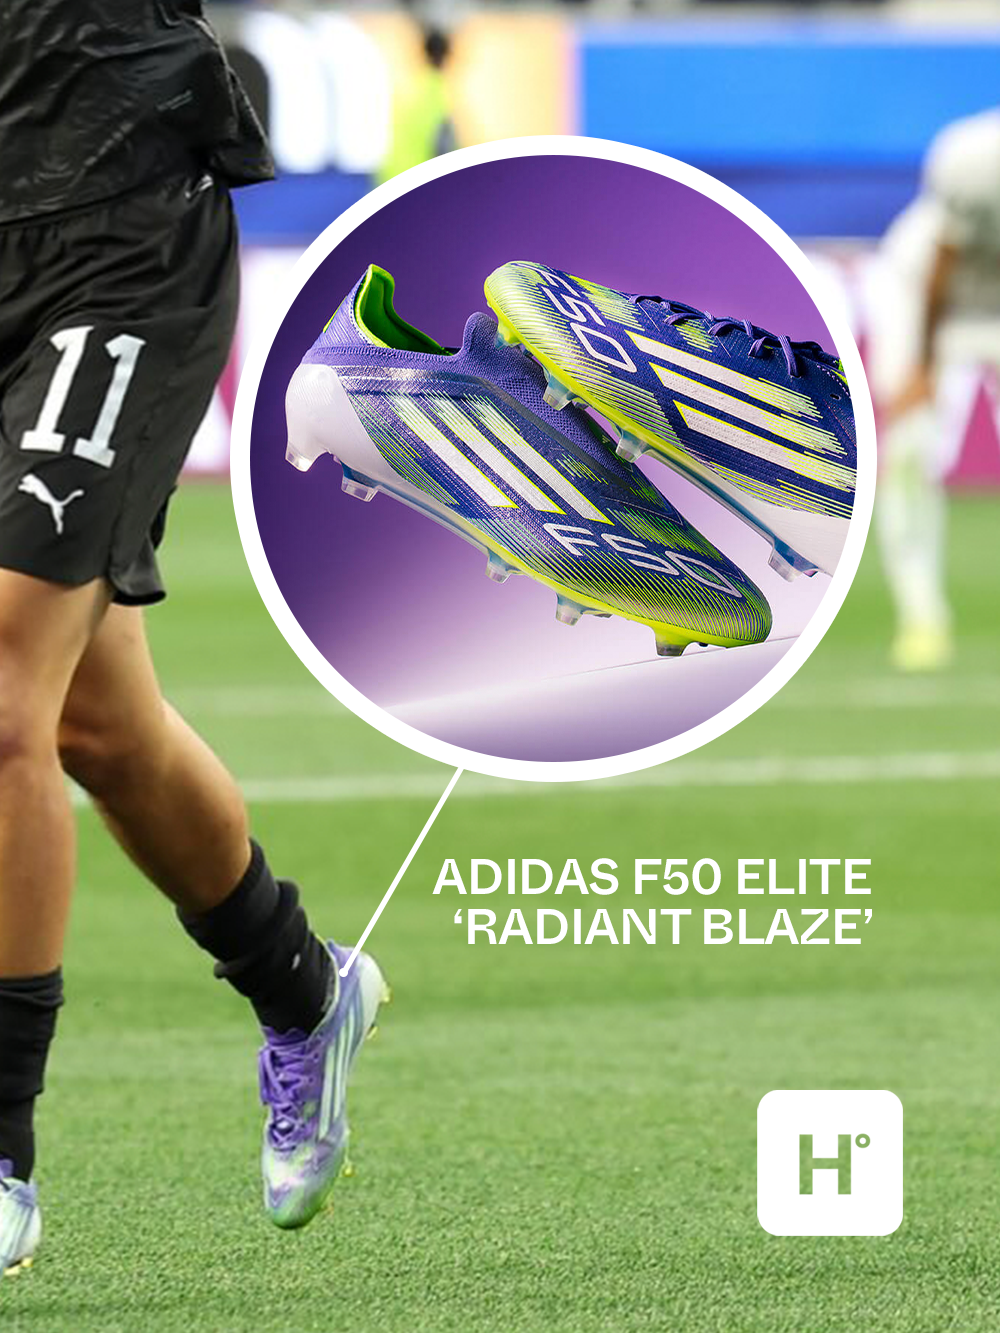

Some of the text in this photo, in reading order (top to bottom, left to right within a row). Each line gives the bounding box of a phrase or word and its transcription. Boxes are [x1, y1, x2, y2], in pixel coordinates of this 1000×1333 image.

[511, 262, 638, 373] F50
[20, 325, 146, 468] 11
[542, 522, 743, 599] F50
